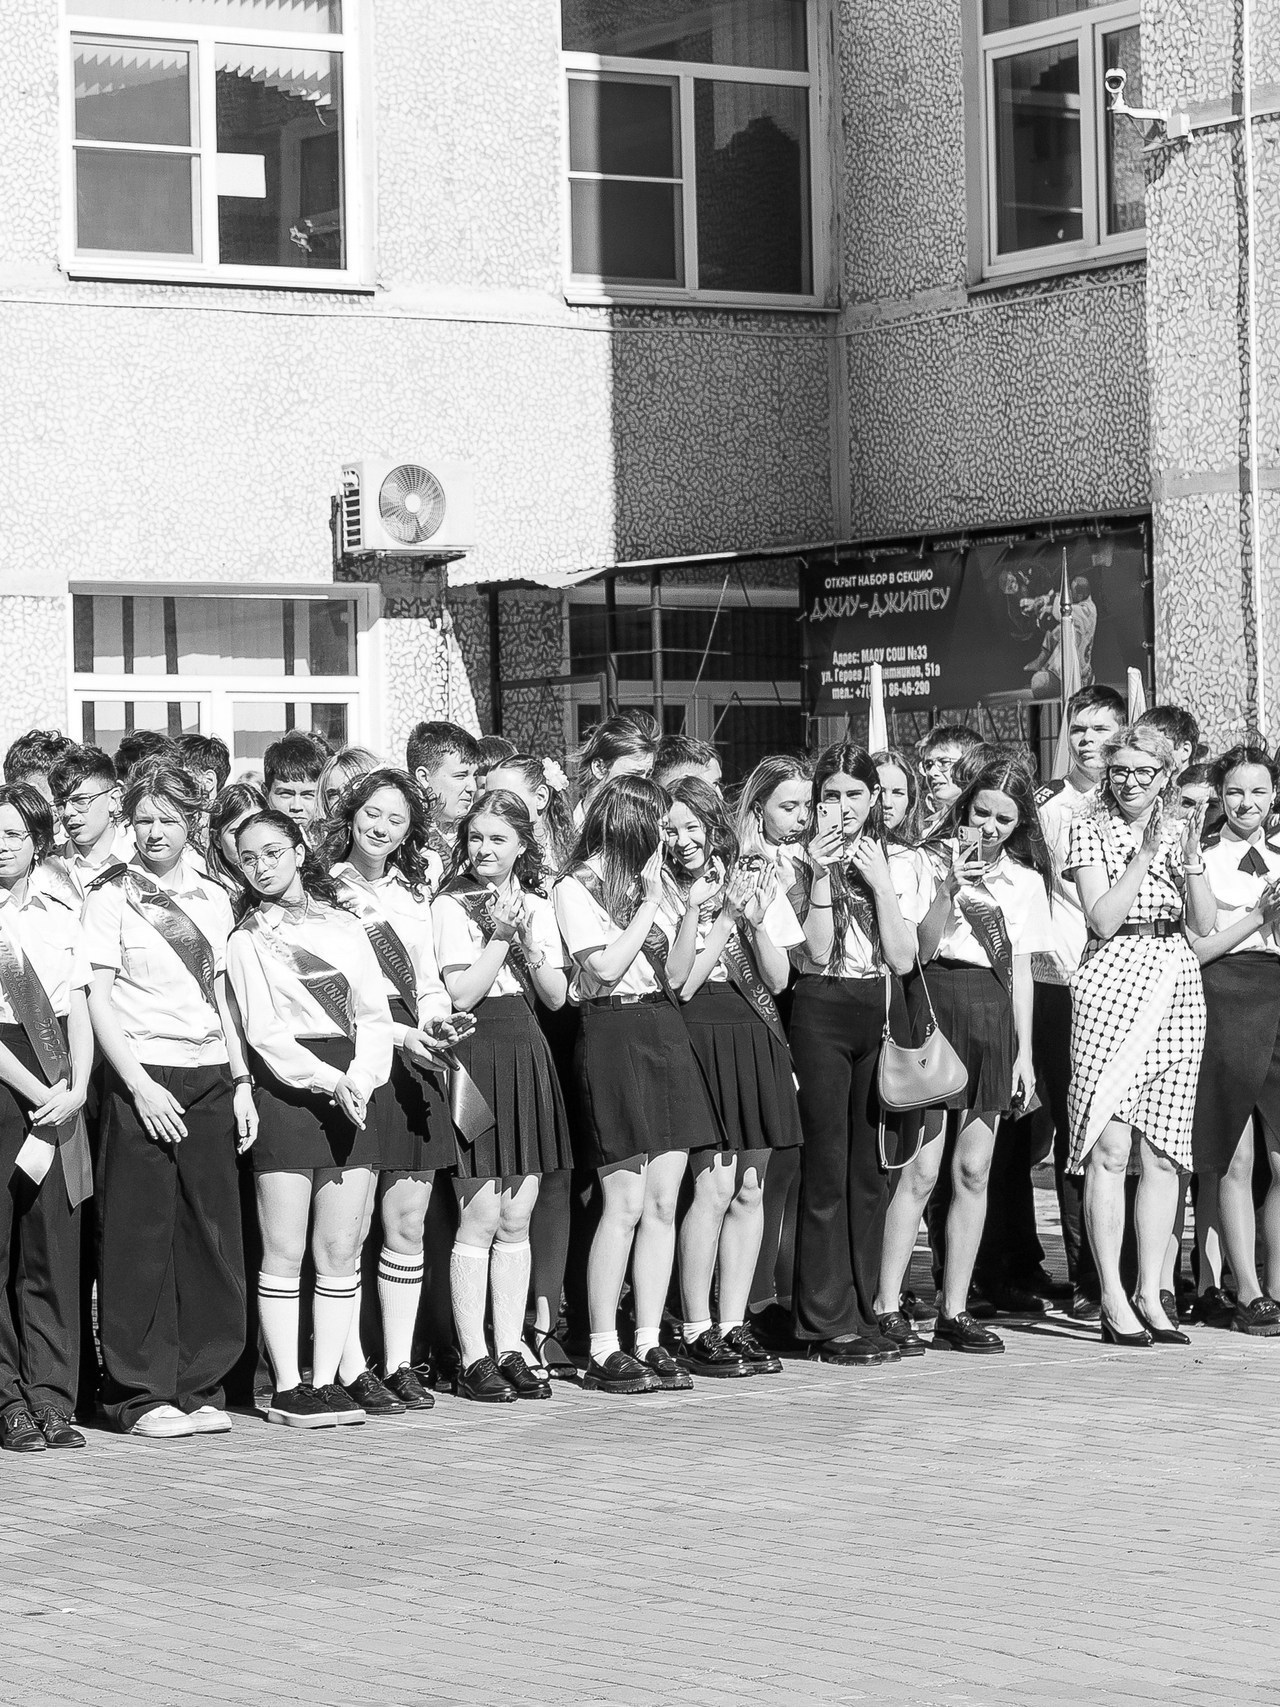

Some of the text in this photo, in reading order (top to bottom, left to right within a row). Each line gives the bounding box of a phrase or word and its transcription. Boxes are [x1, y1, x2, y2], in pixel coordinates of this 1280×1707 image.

[824, 568, 933, 589] ОТКРЫТ НАБОР В СЕКЦИЮ
[809, 586, 951, 622] ДЖИУ-ДЖИТСУ
[832, 644, 928, 667] Адрес: МАОУ СОШ №33
[821, 662, 940, 686] ул. Героев Днтников, 51а
[888, 680, 930, 697] 86-46-290
